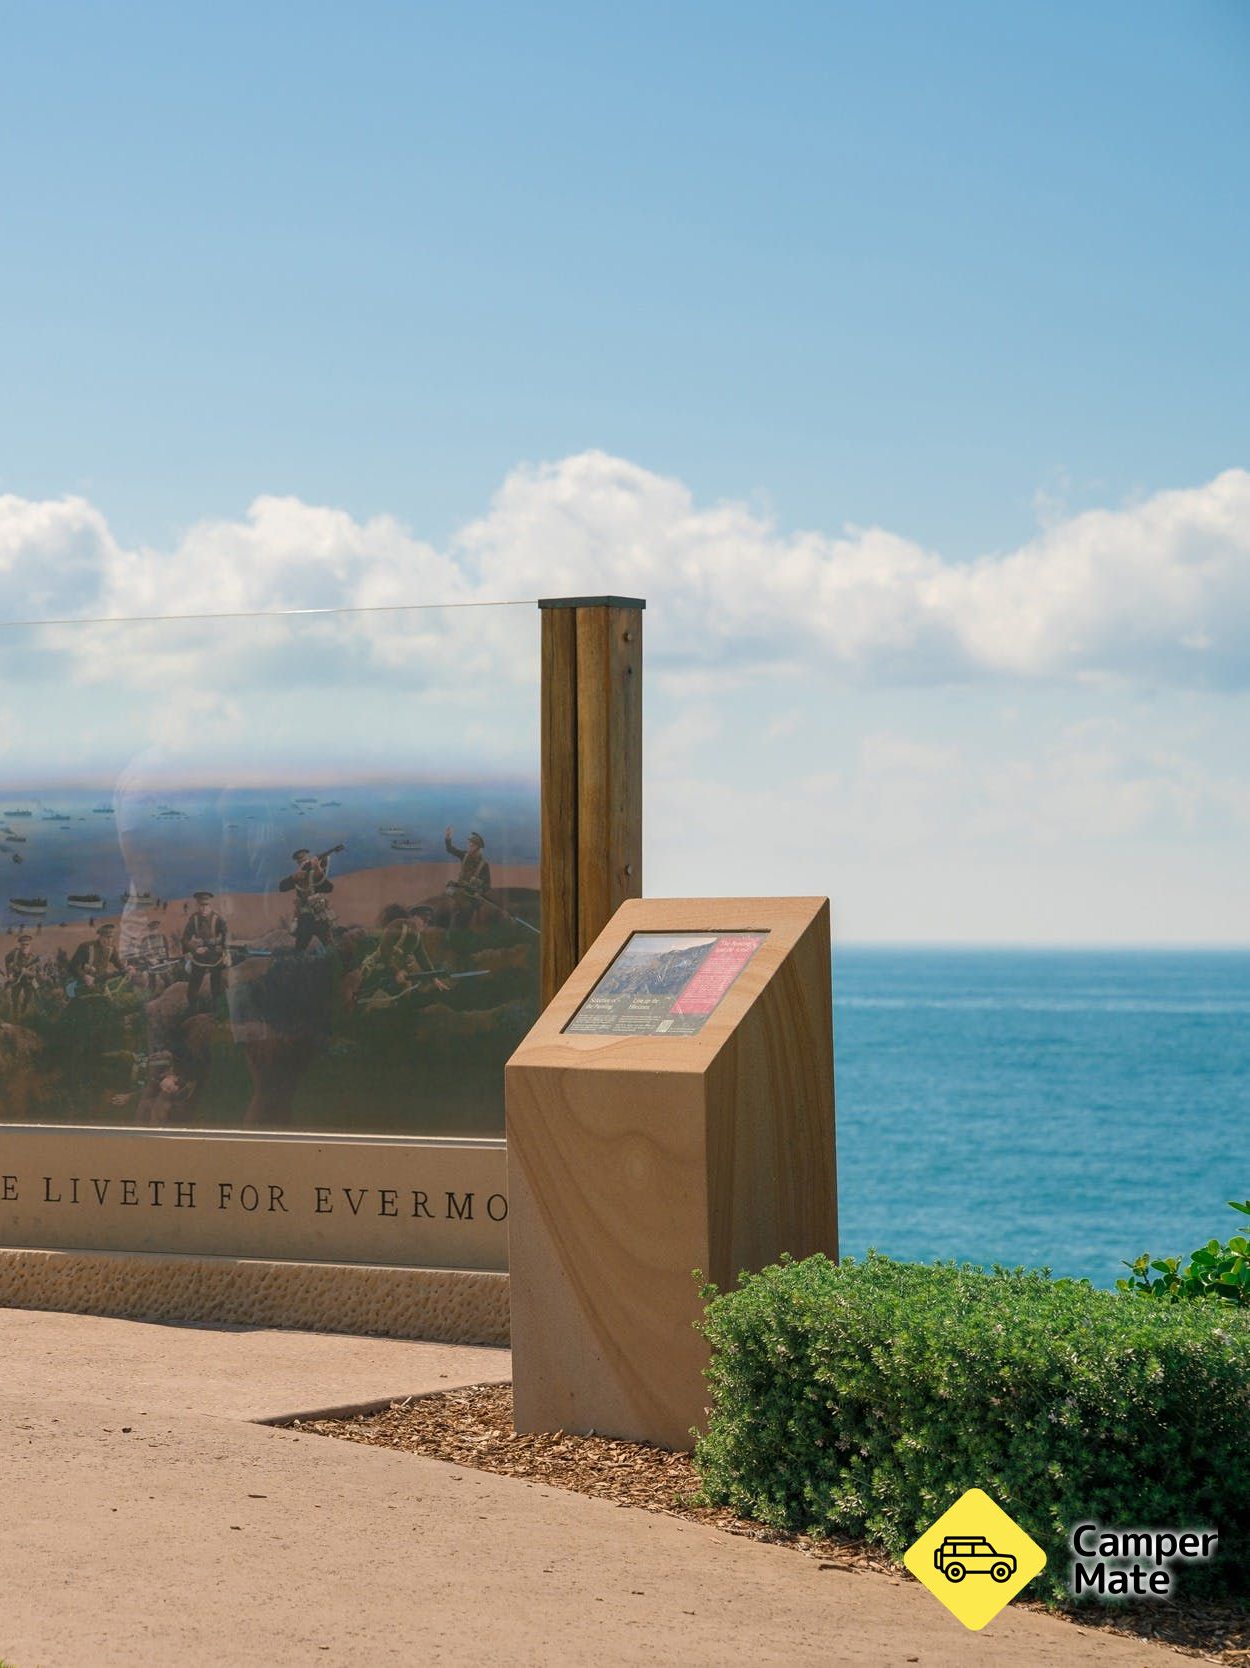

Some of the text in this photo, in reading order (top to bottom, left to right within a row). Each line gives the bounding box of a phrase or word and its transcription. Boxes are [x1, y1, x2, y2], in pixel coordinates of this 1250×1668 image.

[42, 1177, 197, 1209] LIVETH
[217, 1183, 289, 1213] FOR
[314, 1187, 509, 1222] EVERMO
